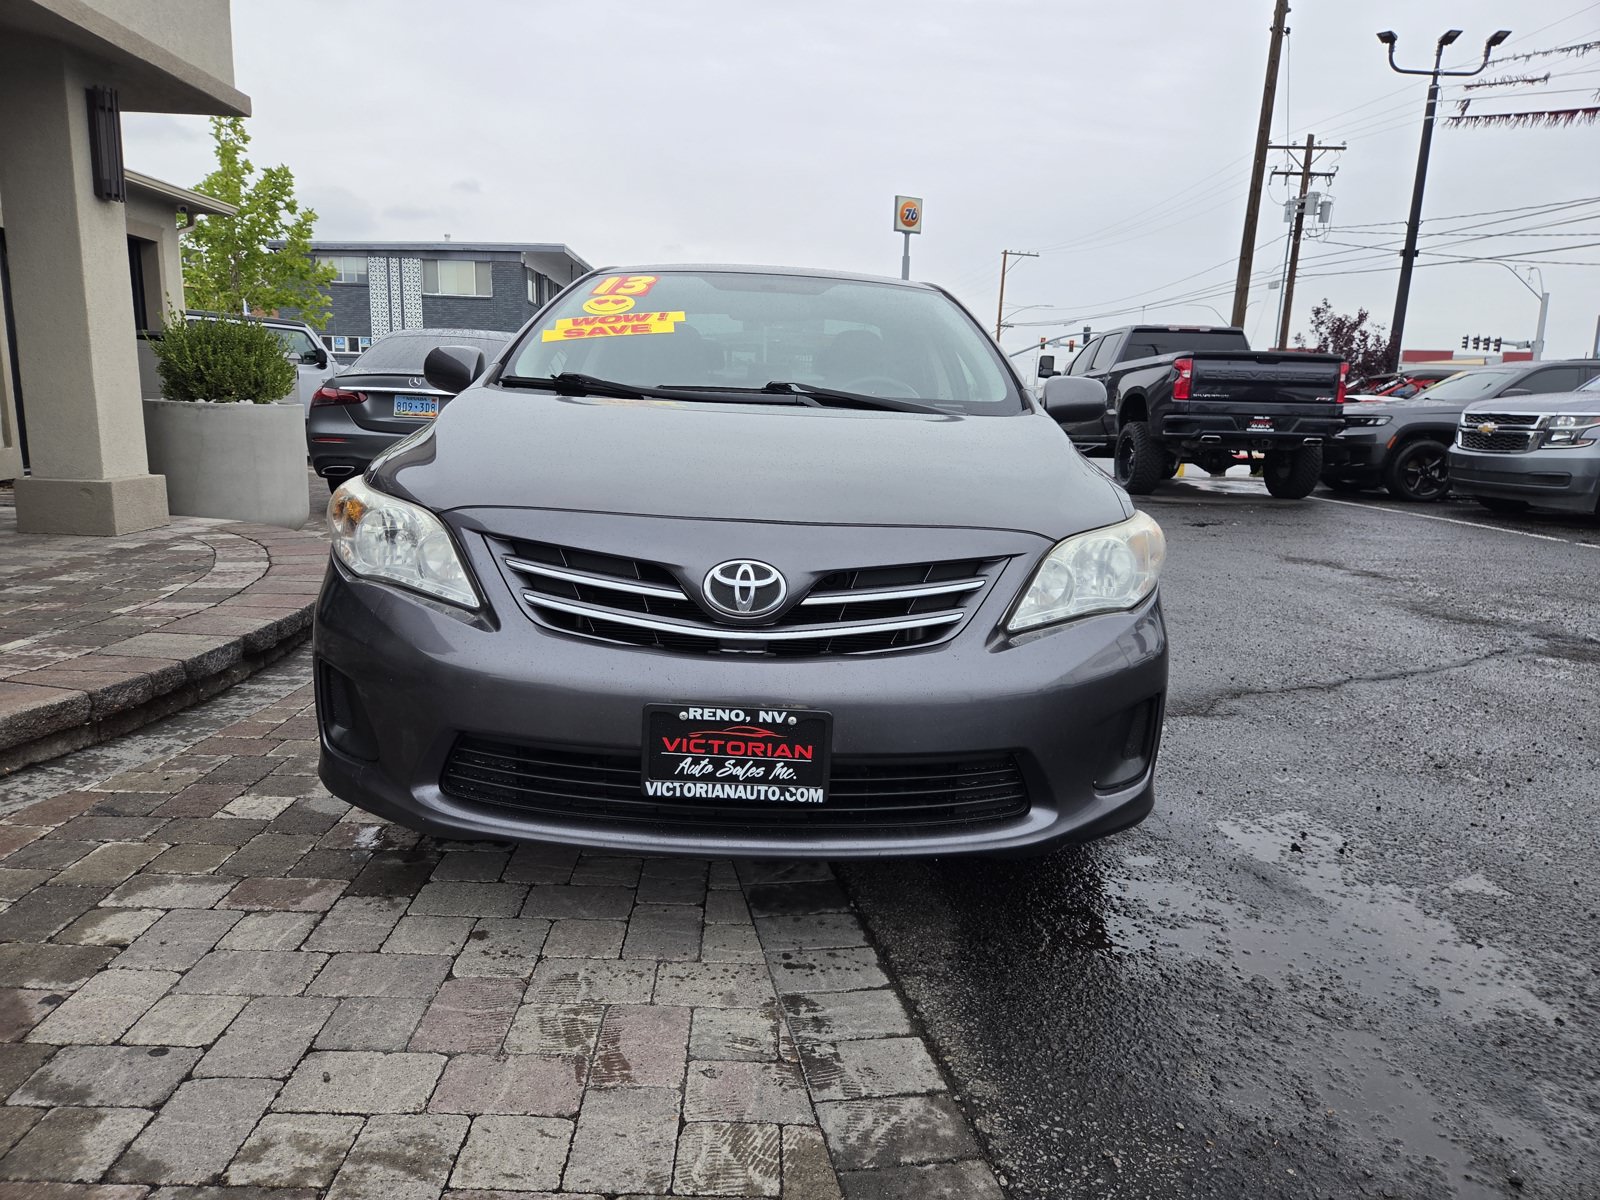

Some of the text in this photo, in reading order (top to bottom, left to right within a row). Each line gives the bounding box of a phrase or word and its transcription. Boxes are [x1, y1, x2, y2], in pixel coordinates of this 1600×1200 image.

[904, 207, 918, 221] 76
[590, 275, 659, 296] 13
[563, 323, 652, 338] SAVE
[688, 707, 788, 724] RENO, NV
[662, 737, 813, 760] VICTORIAN
[675, 757, 797, 781] Auto Sales Inc.
[645, 782, 824, 803] VICTORIANAUTO.COM
